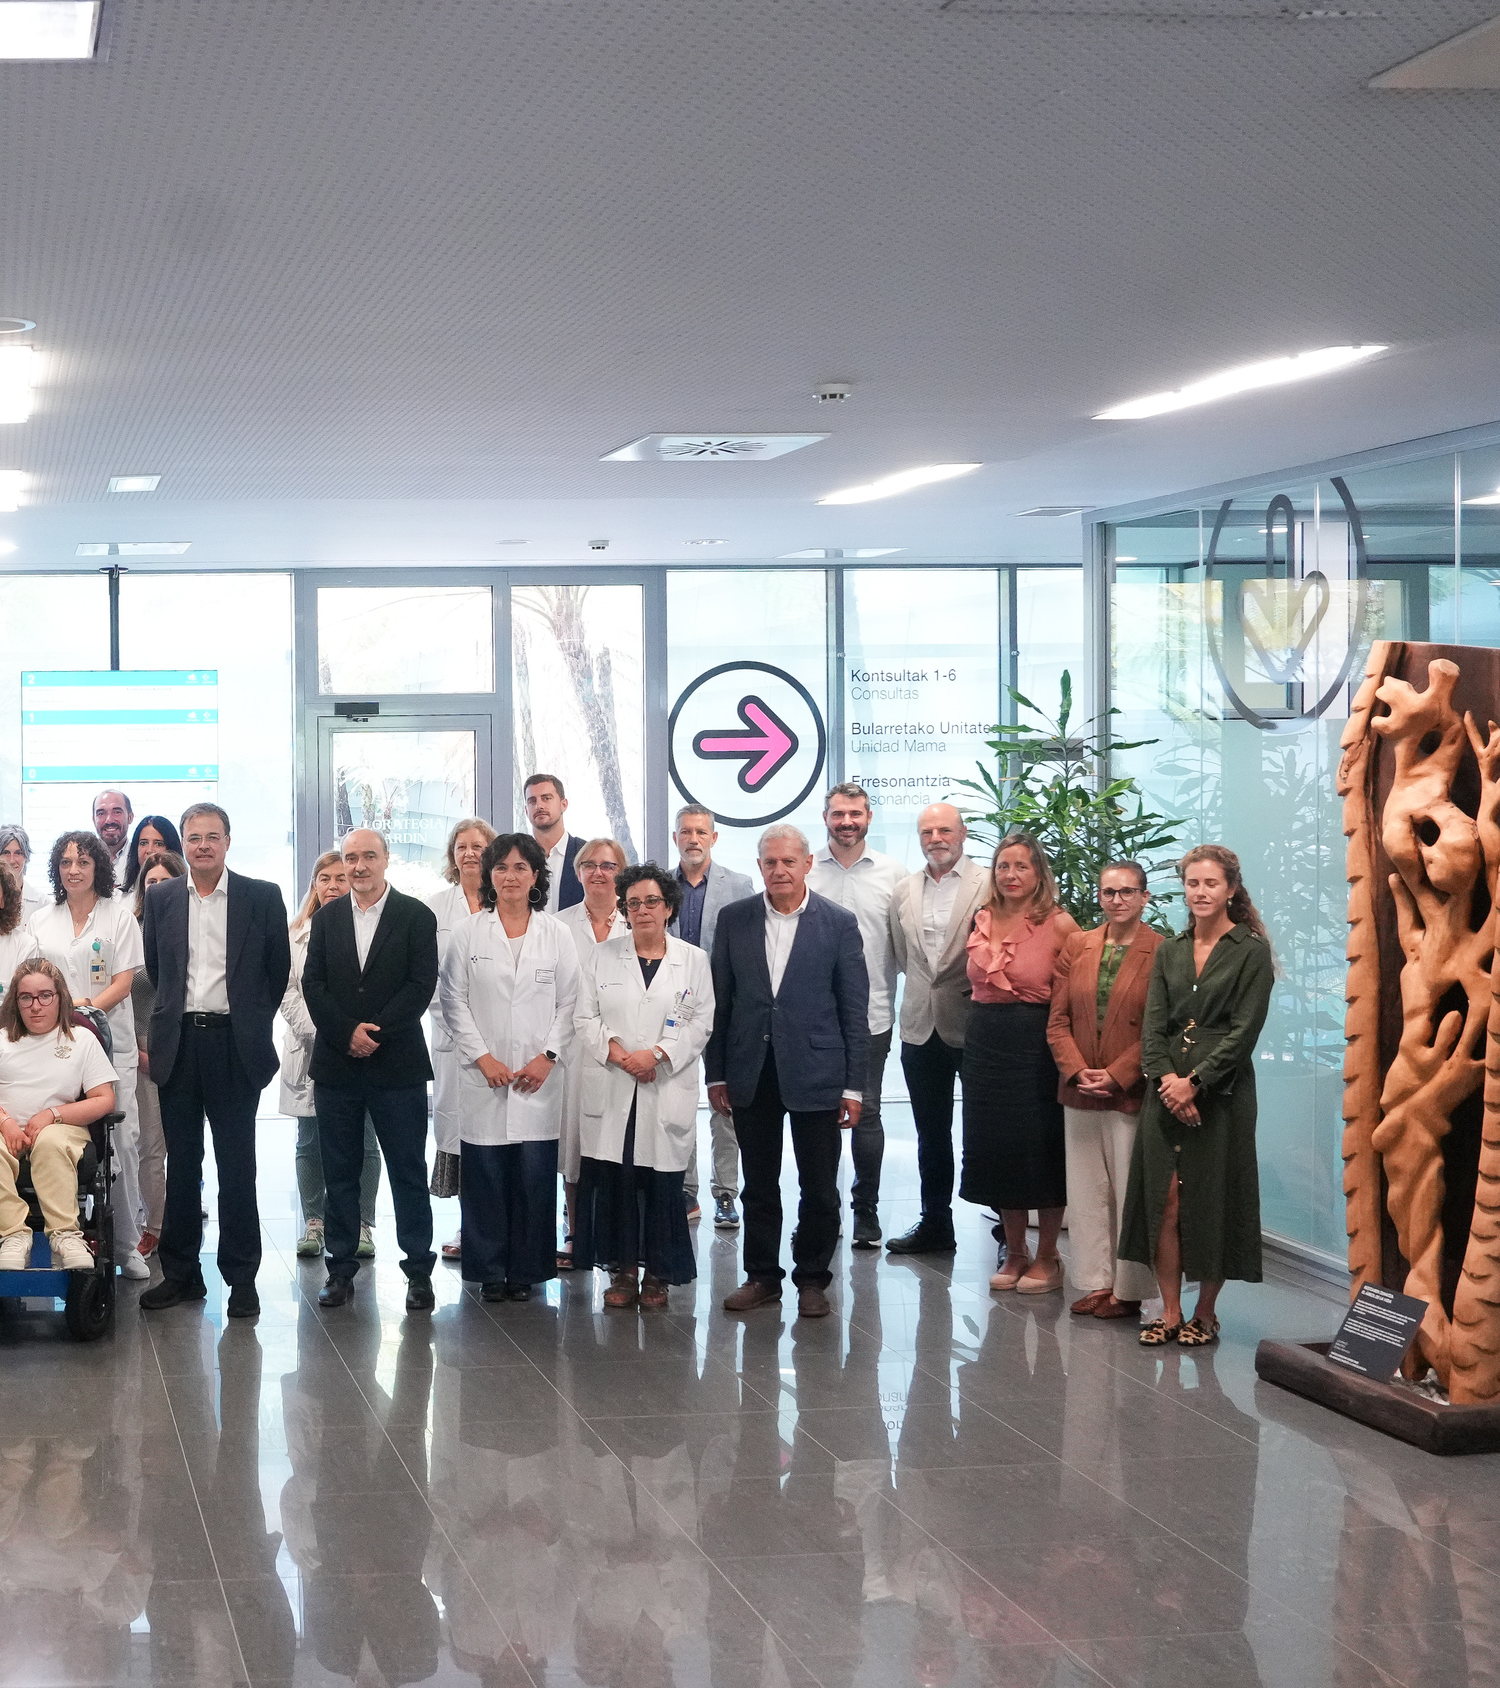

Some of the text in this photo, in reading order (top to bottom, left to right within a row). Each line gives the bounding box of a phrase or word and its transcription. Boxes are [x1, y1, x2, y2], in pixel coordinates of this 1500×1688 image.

[27, 674, 36, 685] 2
[851, 669, 957, 682] Kontsultak 1-6
[851, 687, 920, 701] Consultas
[29, 713, 35, 723] 1
[851, 722, 935, 736] Bularretako
[851, 739, 947, 753] Unidad Mama
[29, 769, 37, 779] 0
[852, 774, 951, 788] Erresonantzia
[868, 792, 931, 806] sonancia
